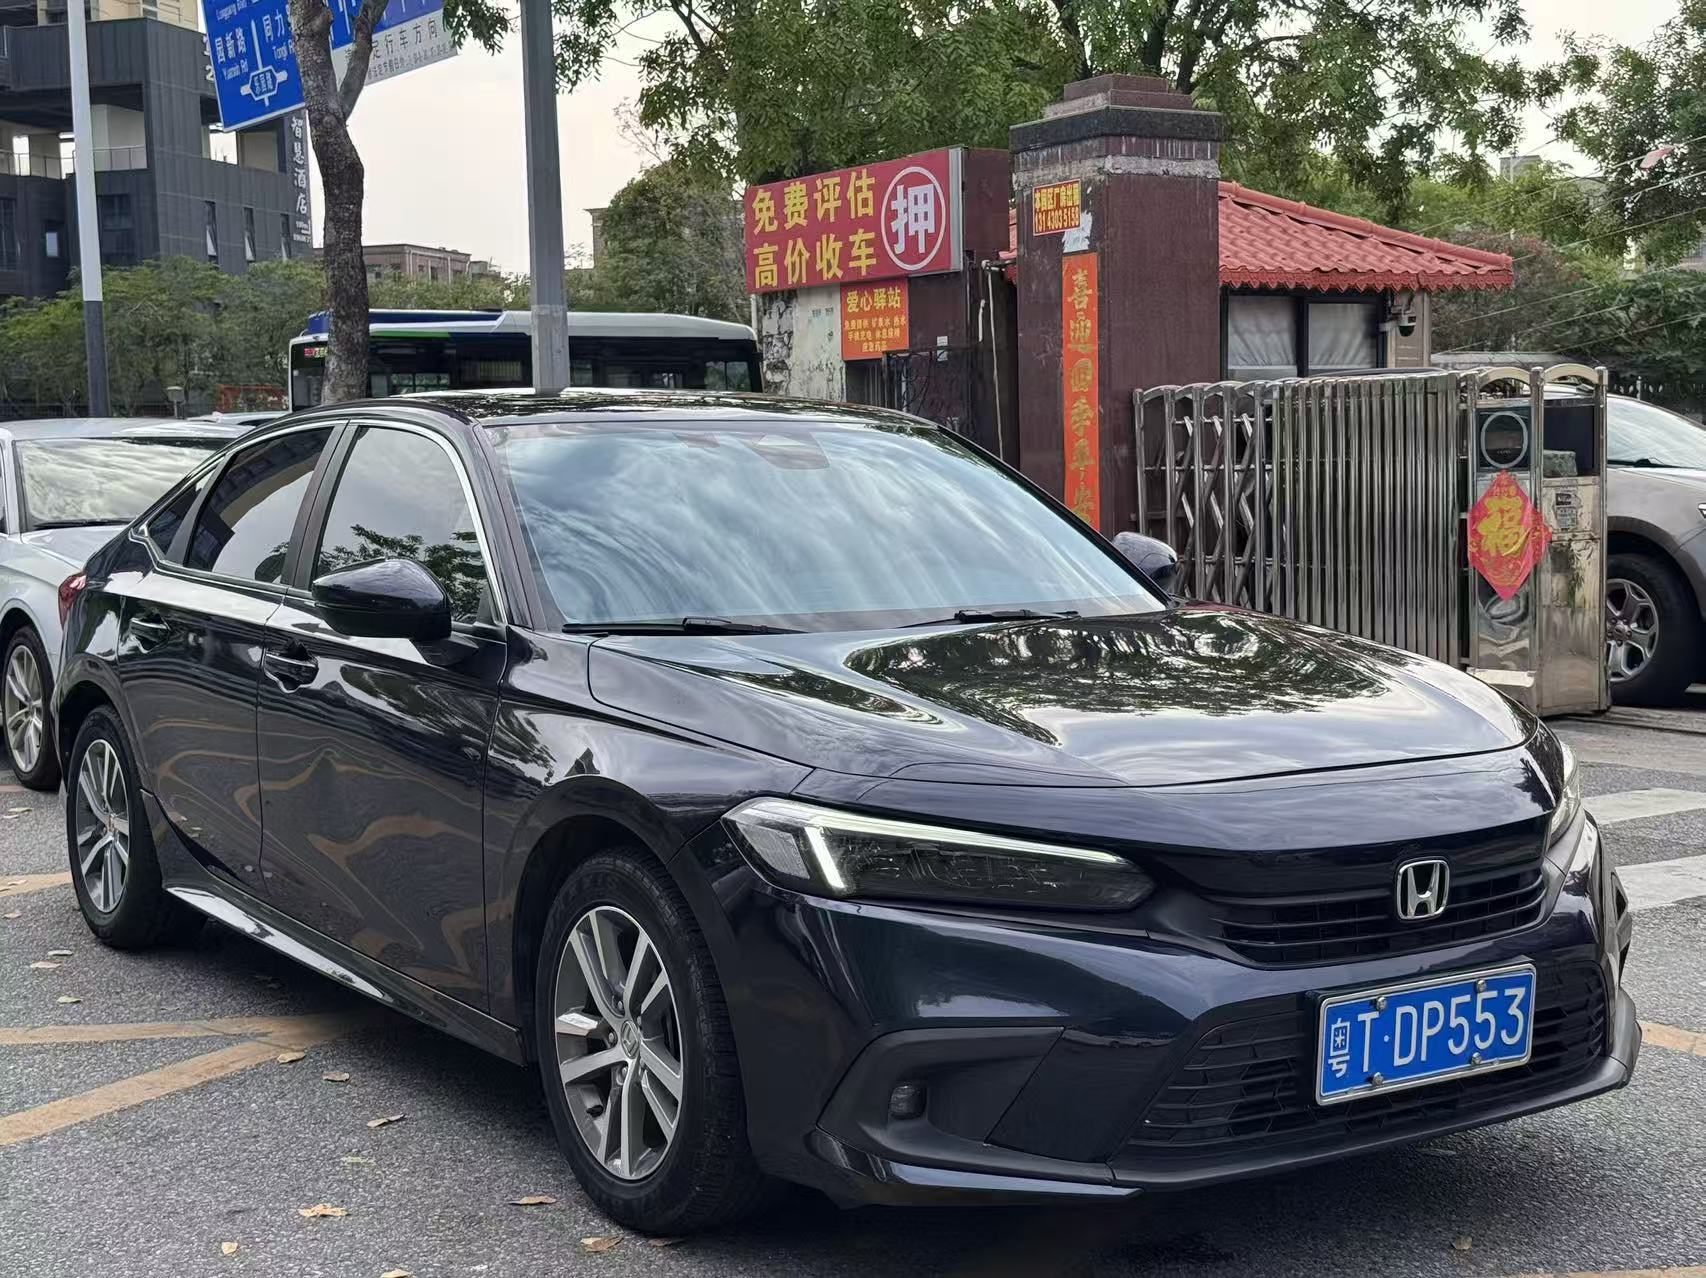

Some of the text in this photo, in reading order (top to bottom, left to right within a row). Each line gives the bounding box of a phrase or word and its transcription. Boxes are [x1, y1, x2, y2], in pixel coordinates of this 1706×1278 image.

[751, 169, 876, 236] 免费评估
[890, 183, 937, 255] 押
[753, 228, 877, 289] 高价收车
[846, 286, 901, 313] 爱心驿站
[1477, 495, 1527, 558] 福
